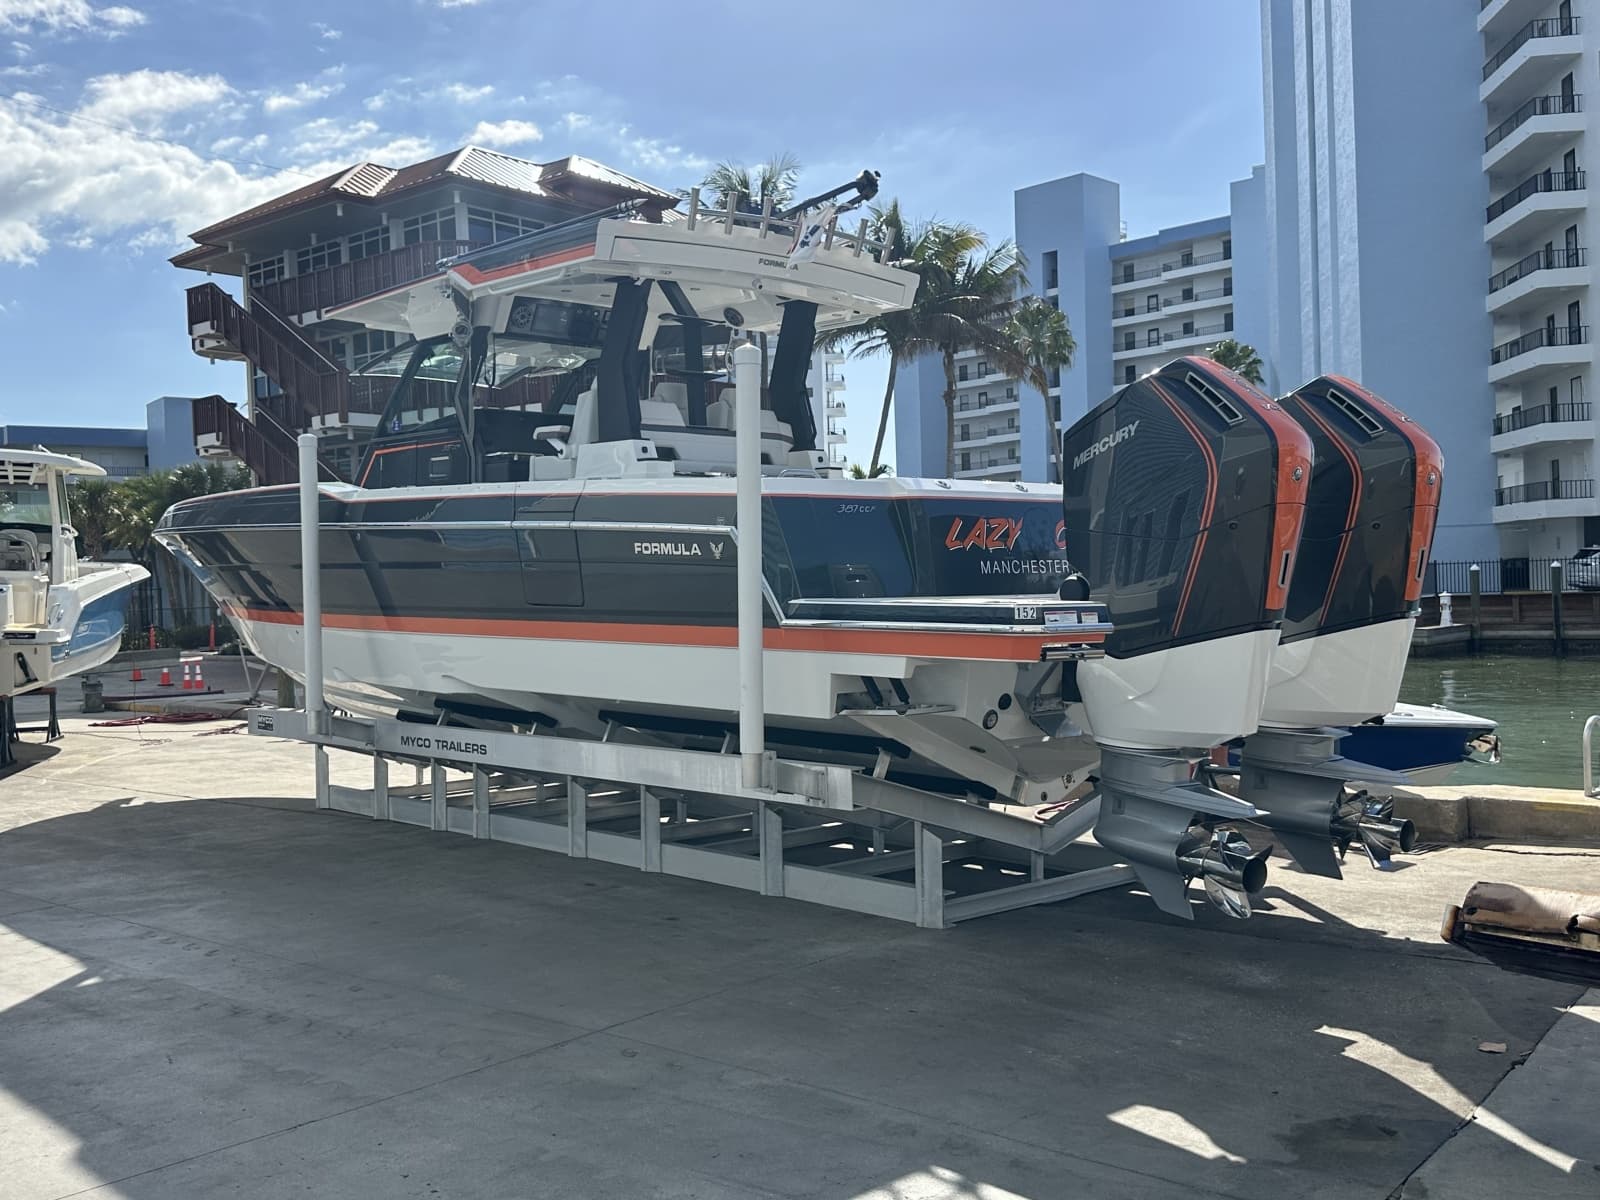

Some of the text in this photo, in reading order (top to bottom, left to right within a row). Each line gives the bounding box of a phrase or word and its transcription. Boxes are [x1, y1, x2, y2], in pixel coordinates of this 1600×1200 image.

[758, 258, 799, 271] FORMUA
[1073, 420, 1141, 470] MERCURY
[945, 516, 1024, 553] LAZY
[634, 542, 702, 556] FORMULA
[1016, 607, 1036, 619] 152
[400, 735, 488, 755] MYCO TRAILERS
